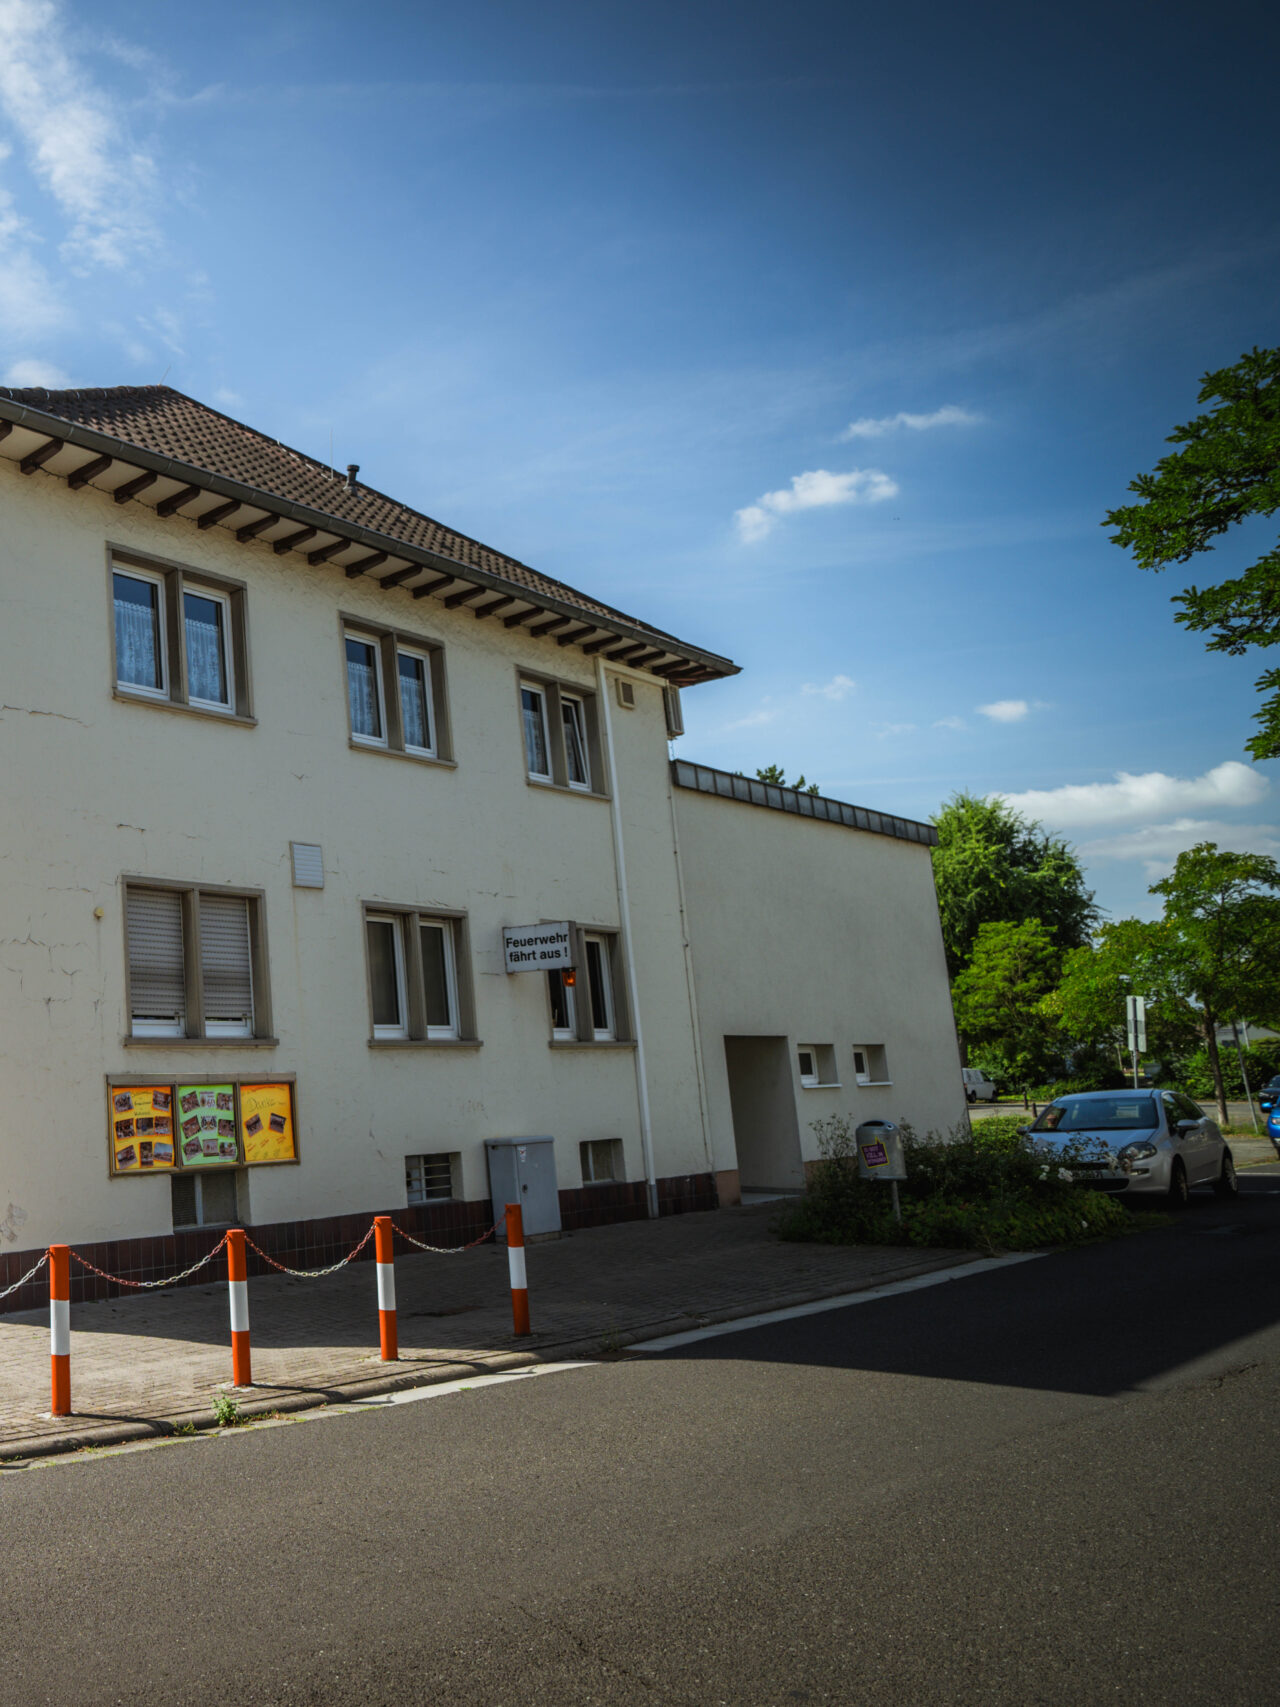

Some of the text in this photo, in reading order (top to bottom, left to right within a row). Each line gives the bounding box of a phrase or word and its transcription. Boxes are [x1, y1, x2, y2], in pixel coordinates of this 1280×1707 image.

[506, 932, 568, 949] Feuerwehr
[509, 950, 537, 963] fährt
[539, 949, 561, 960] aus
